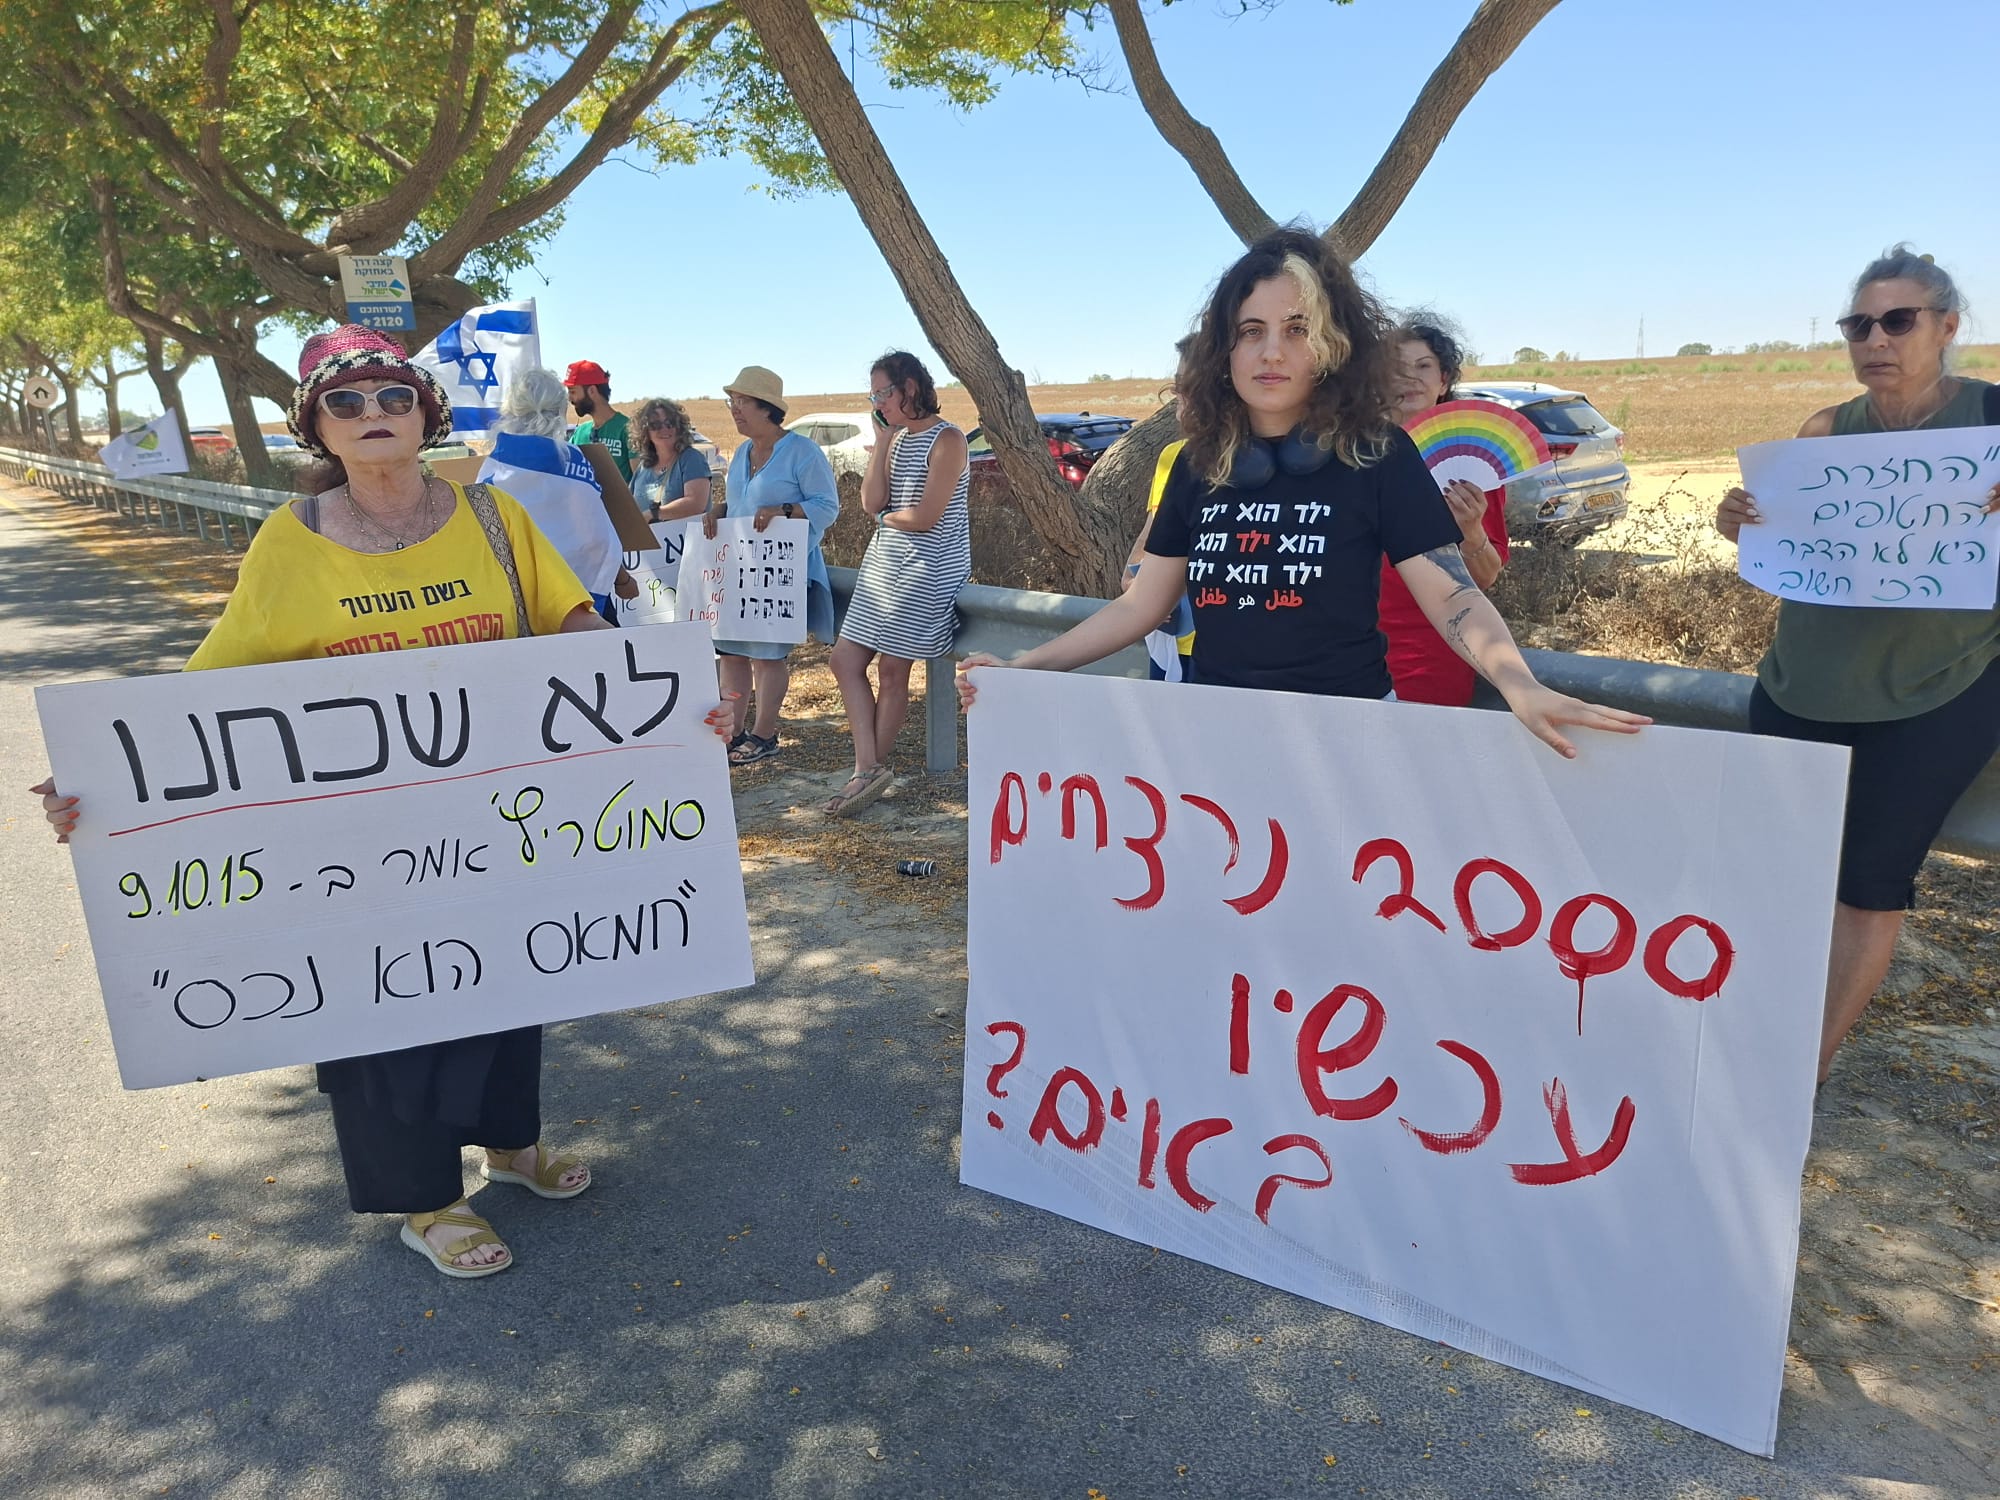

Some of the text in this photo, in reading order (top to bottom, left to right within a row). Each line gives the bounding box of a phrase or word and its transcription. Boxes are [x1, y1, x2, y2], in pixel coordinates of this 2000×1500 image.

[360, 305, 402, 314] לשרותכם
[1201, 501, 1331, 524] ילד הוא ילד
[1813, 493, 1988, 529] החטופים
[1194, 530, 1326, 554] הוא ילד הוא
[1778, 533, 1986, 565] היא לא הדבר
[1225, 563, 1269, 584] הוא
[1283, 561, 1322, 585] ילד
[1872, 575, 1942, 601] הכי
[339, 579, 473, 618] בשם העוטף
[1195, 587, 1303, 611] طفل هو طفل
[112, 640, 680, 803] לא שכחנו
[491, 779, 706, 864] סמוטריץ'
[382, 837, 489, 887] אמר
[118, 847, 264, 919] 9.10.15
[990, 771, 1736, 1002] 2000 נרצחים
[374, 938, 482, 1003] הוא
[1229, 972, 1636, 1186] עכשיו
